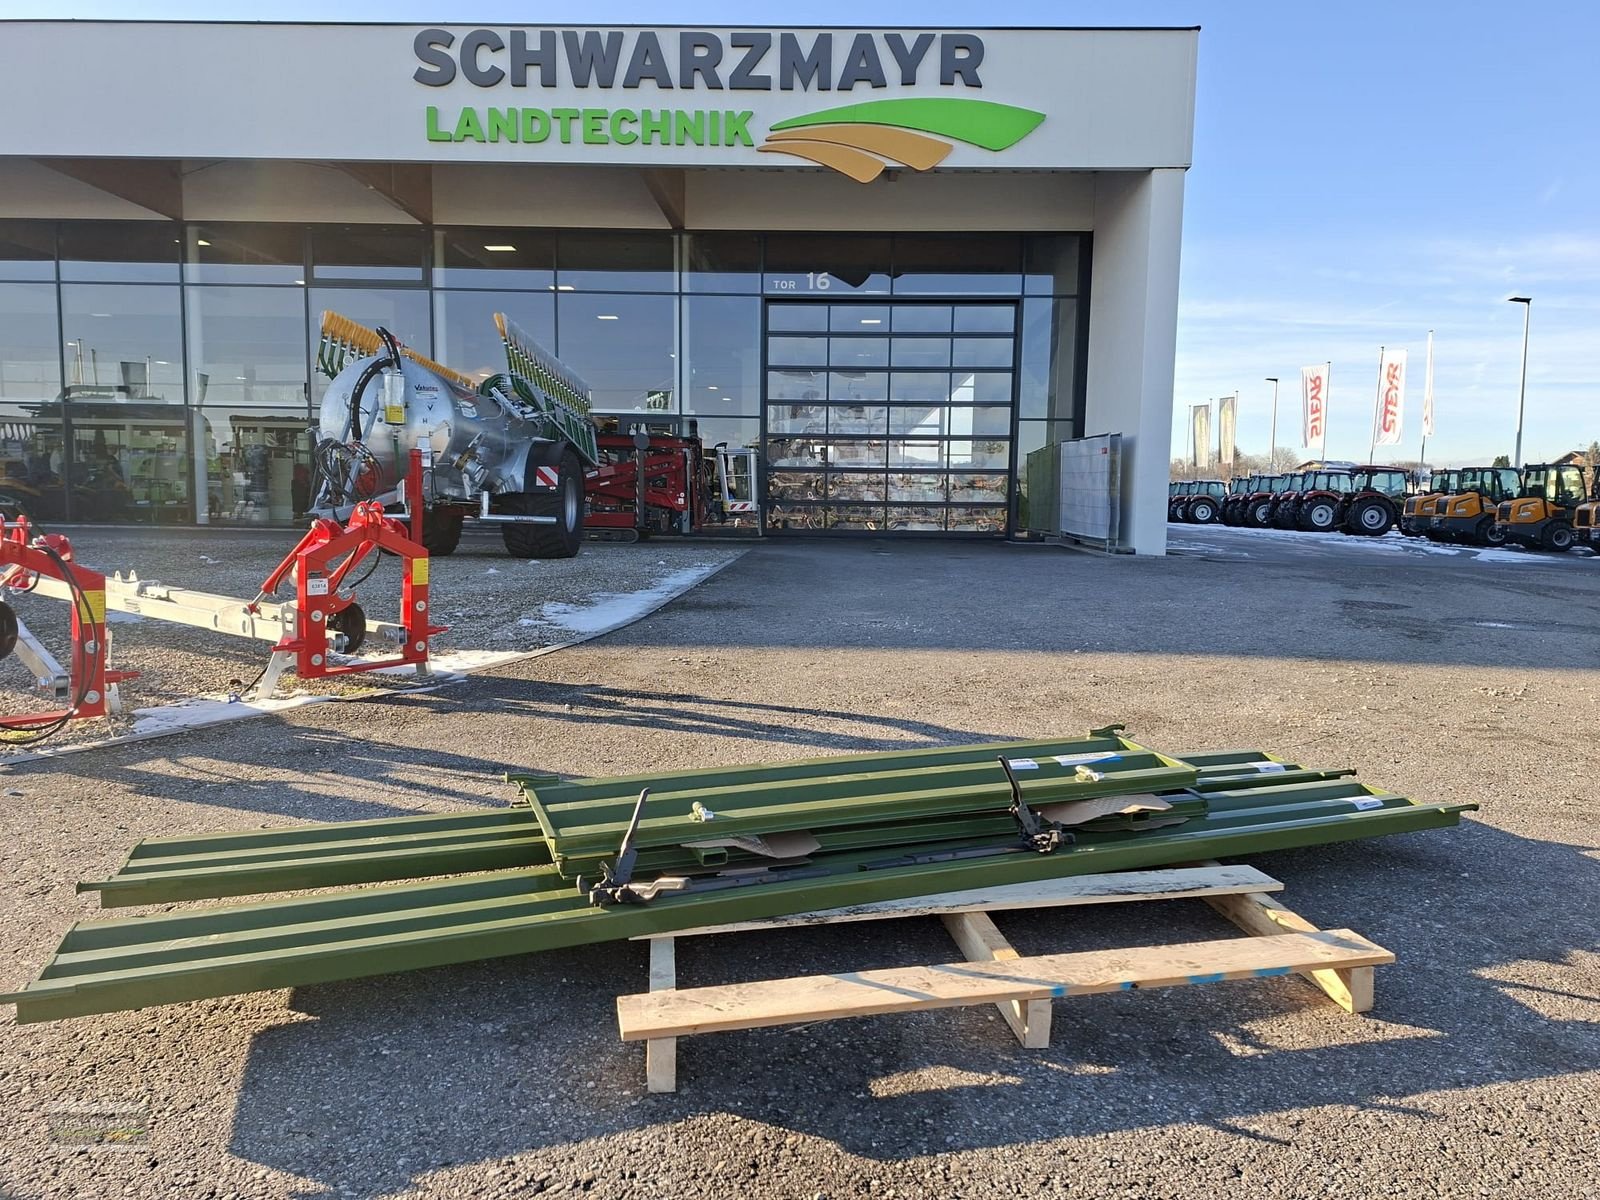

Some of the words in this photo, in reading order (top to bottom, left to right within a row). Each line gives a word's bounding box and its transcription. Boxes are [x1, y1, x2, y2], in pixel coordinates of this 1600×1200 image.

[412, 28, 985, 91] SCHWARZMAYR
[426, 106, 754, 146] LANDTECHNIK
[773, 280, 796, 289] TOR
[807, 272, 831, 290] 16
[1383, 362, 1399, 434] STEYR
